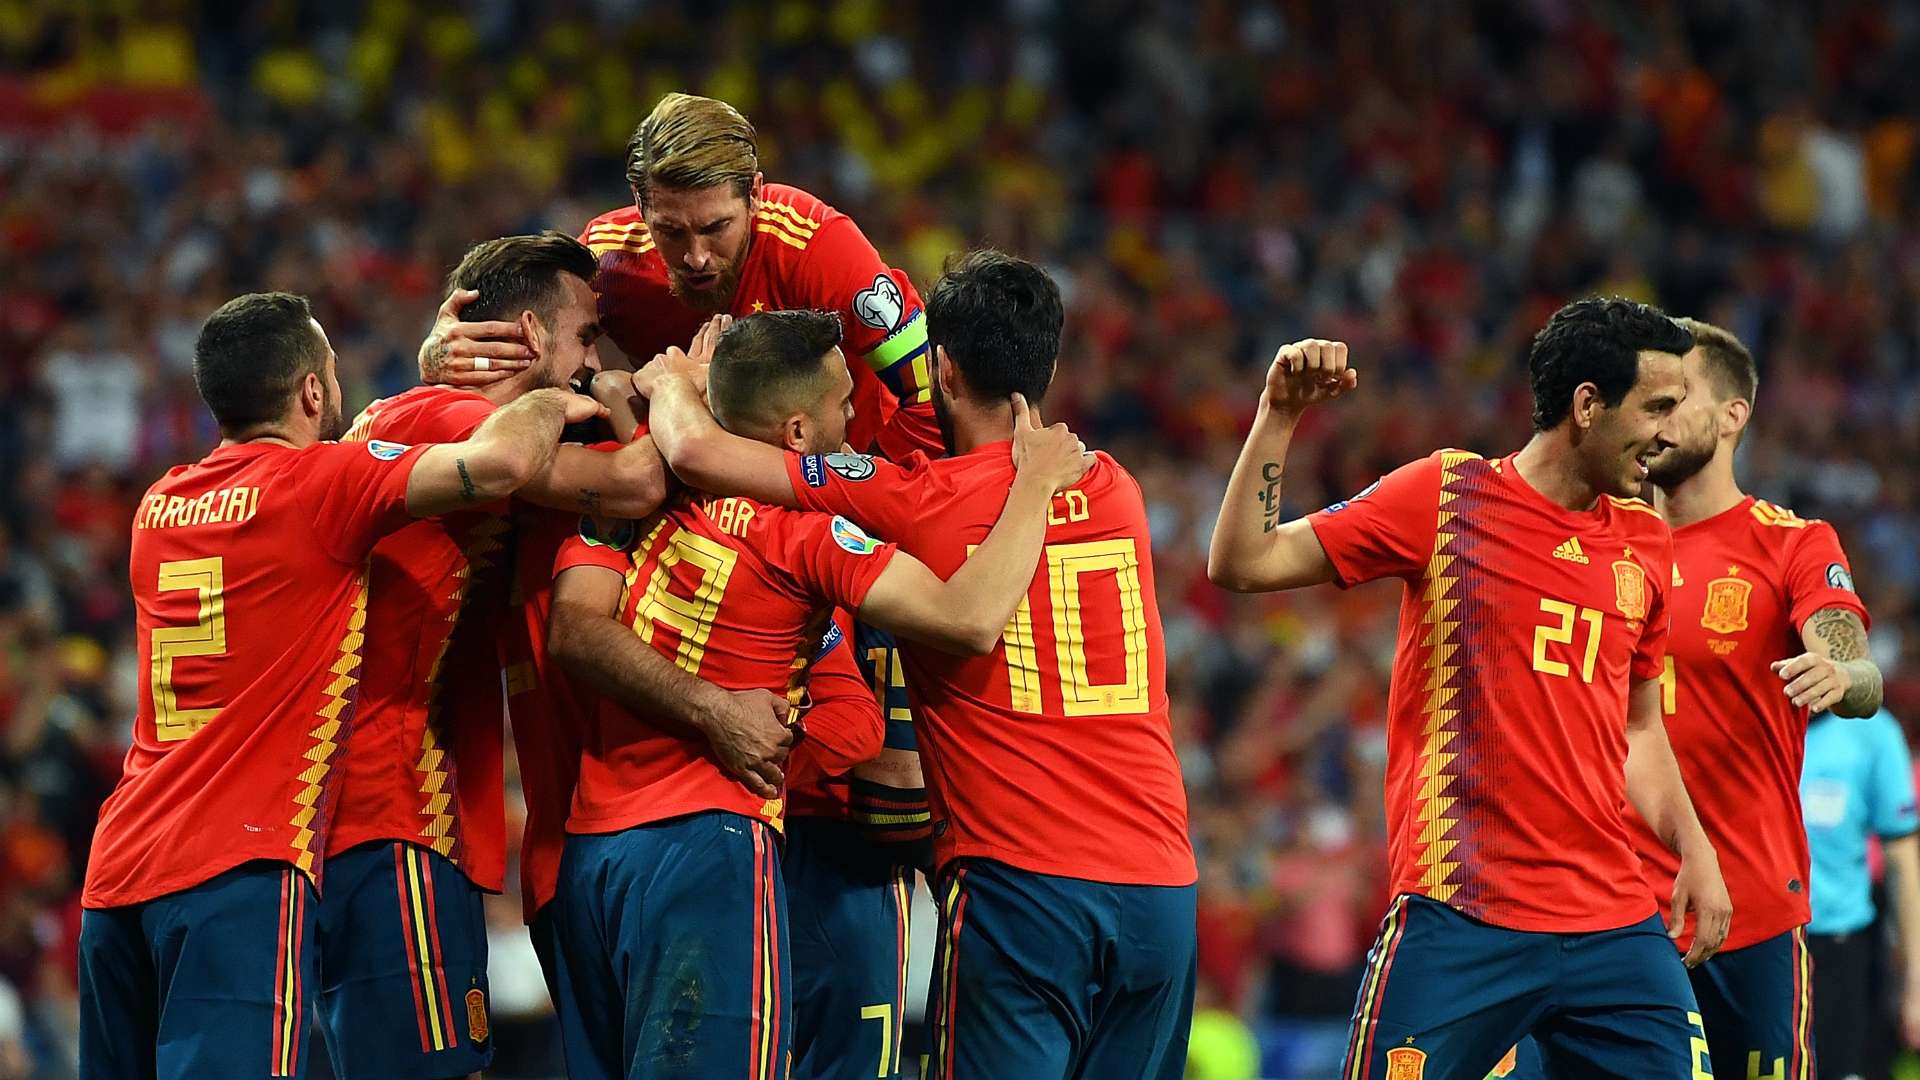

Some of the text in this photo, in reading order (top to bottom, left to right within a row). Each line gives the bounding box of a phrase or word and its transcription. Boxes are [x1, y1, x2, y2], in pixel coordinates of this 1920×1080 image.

[1552, 550, 1590, 564] adidas
[151, 556, 226, 742] 2
[1533, 598, 1604, 684] 21
[861, 1004, 891, 1077] 7
